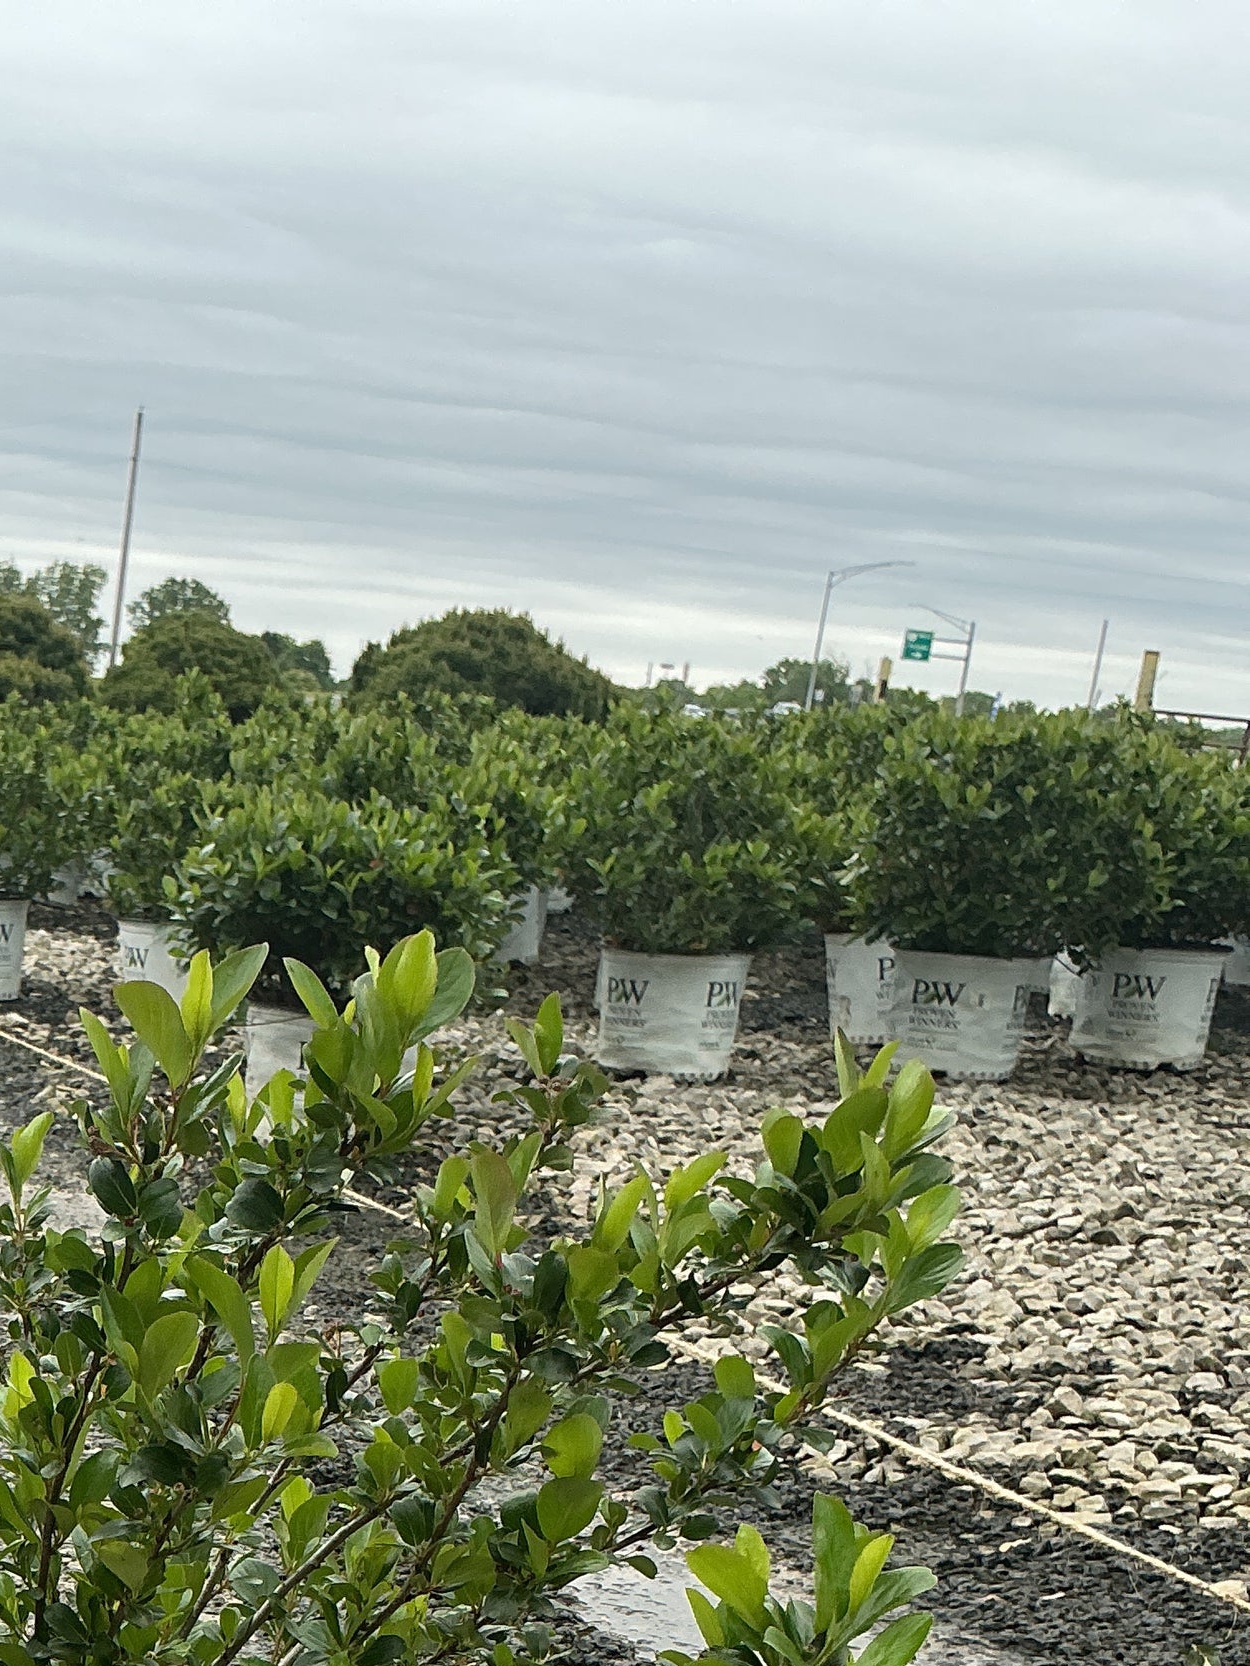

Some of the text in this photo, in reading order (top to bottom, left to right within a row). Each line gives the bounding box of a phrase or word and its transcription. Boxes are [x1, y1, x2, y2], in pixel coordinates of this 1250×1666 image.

[877, 957, 896, 981] P
[608, 977, 649, 1006] PW
[912, 978, 967, 1008] PW
[1113, 972, 1168, 1001] PW
